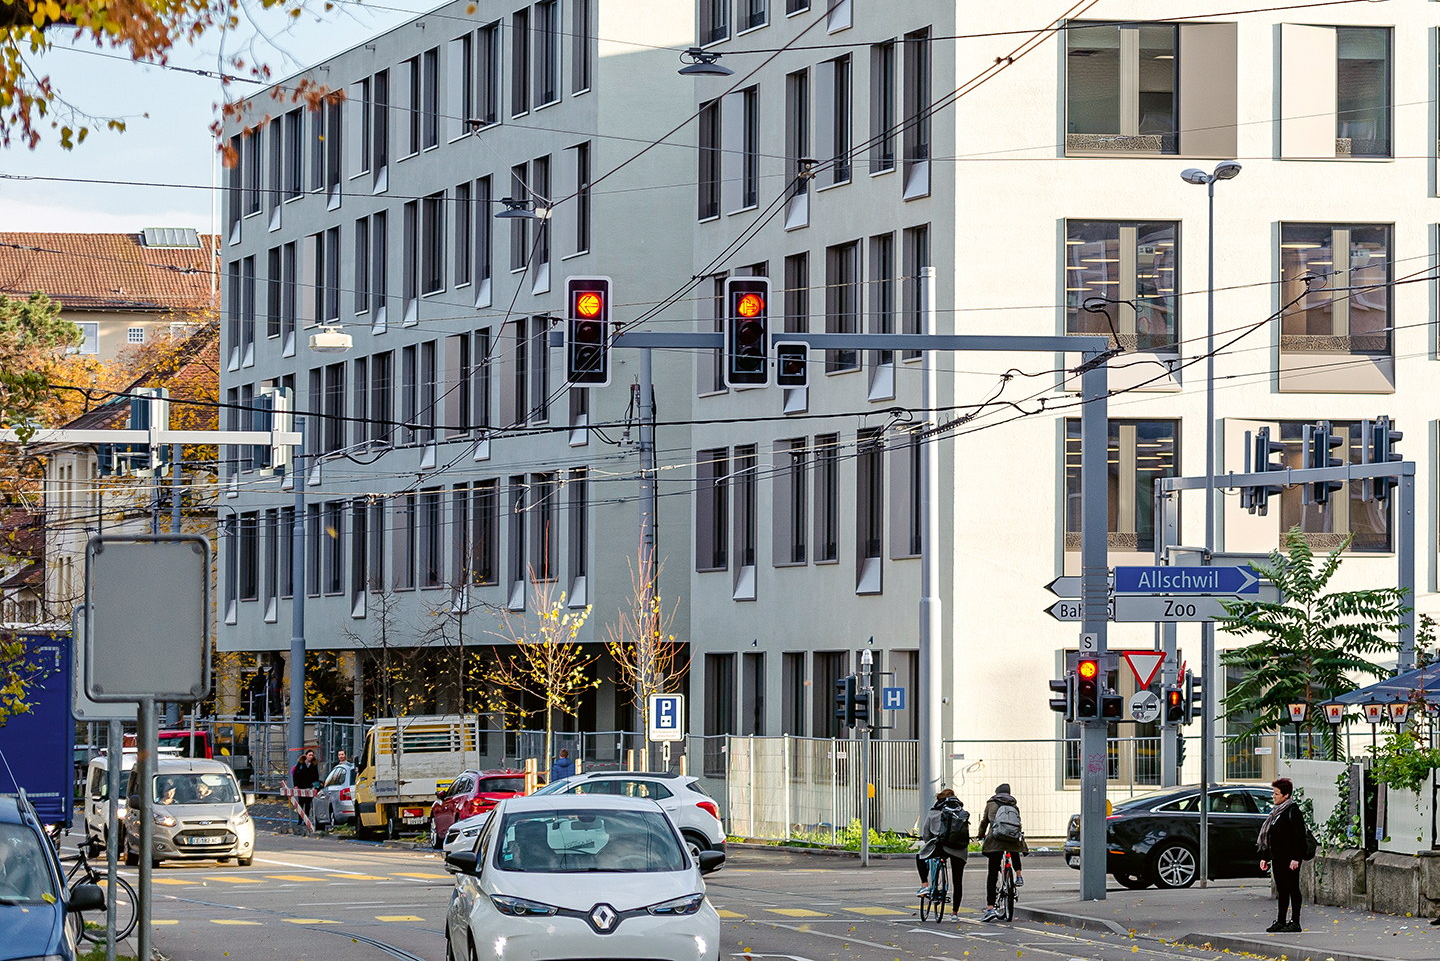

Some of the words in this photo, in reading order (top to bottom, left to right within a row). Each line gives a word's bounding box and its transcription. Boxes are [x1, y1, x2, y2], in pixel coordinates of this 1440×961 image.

[1138, 570, 1218, 588] Allschwil
[1164, 600, 1196, 617] Zoo
[1084, 636, 1092, 649] S
[887, 690, 901, 707] H
[661, 700, 672, 716] P
